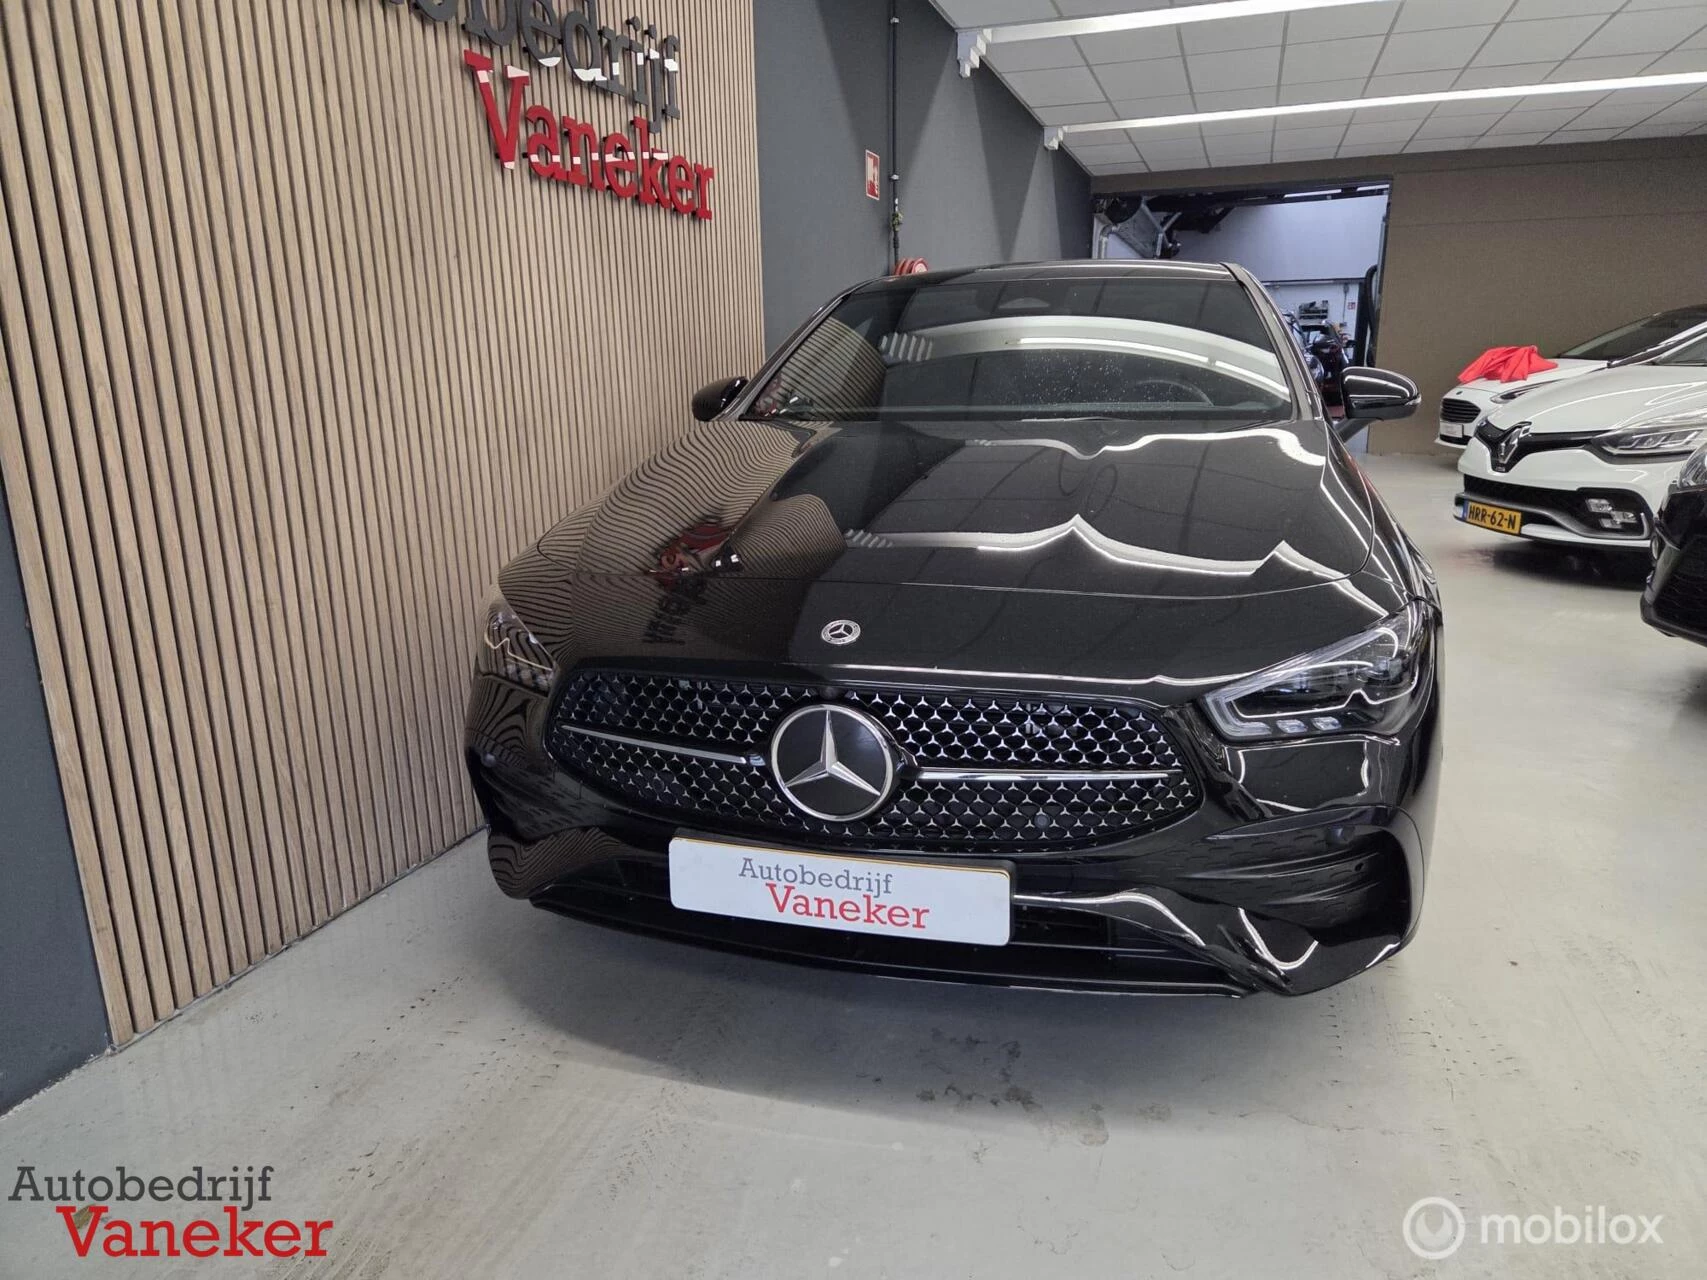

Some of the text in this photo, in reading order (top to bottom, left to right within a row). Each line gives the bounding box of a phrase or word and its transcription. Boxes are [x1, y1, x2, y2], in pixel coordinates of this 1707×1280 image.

[464, 48, 714, 220] Vaneker
[1468, 504, 1517, 530] HRR-62-N
[738, 857, 893, 898] Autobedrijf
[765, 882, 930, 929] Vaneker
